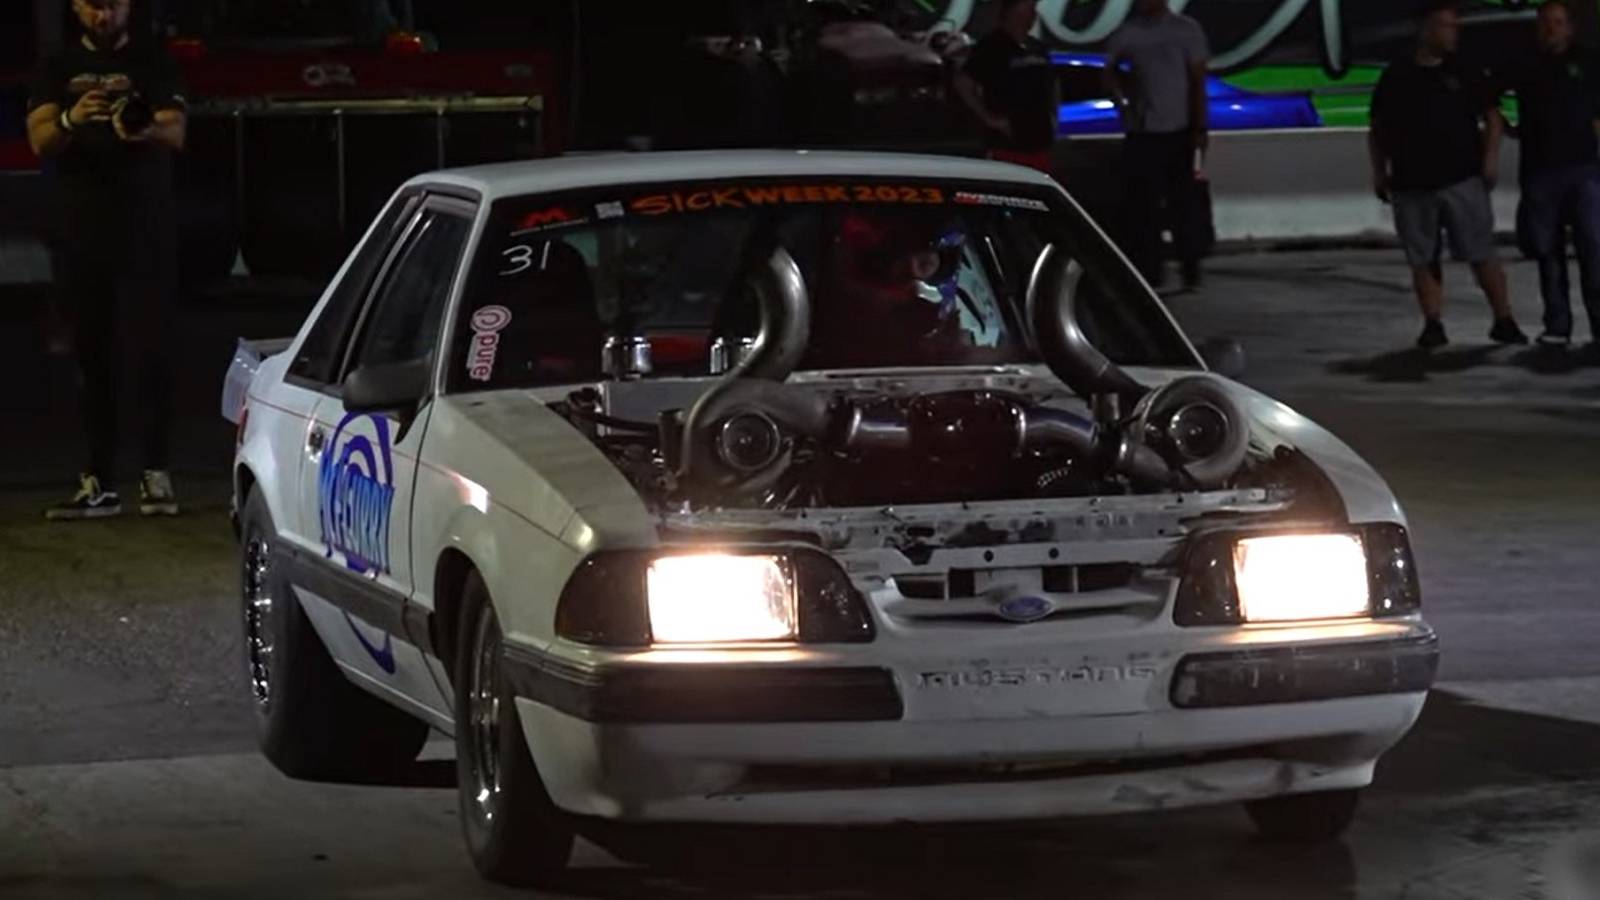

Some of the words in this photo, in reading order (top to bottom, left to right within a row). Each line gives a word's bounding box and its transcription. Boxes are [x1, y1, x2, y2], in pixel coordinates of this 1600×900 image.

[631, 188, 745, 215] SICK
[745, 185, 850, 205] WEEK
[855, 185, 944, 204] 2023
[498, 241, 551, 276] 31
[472, 334, 497, 377] pure
